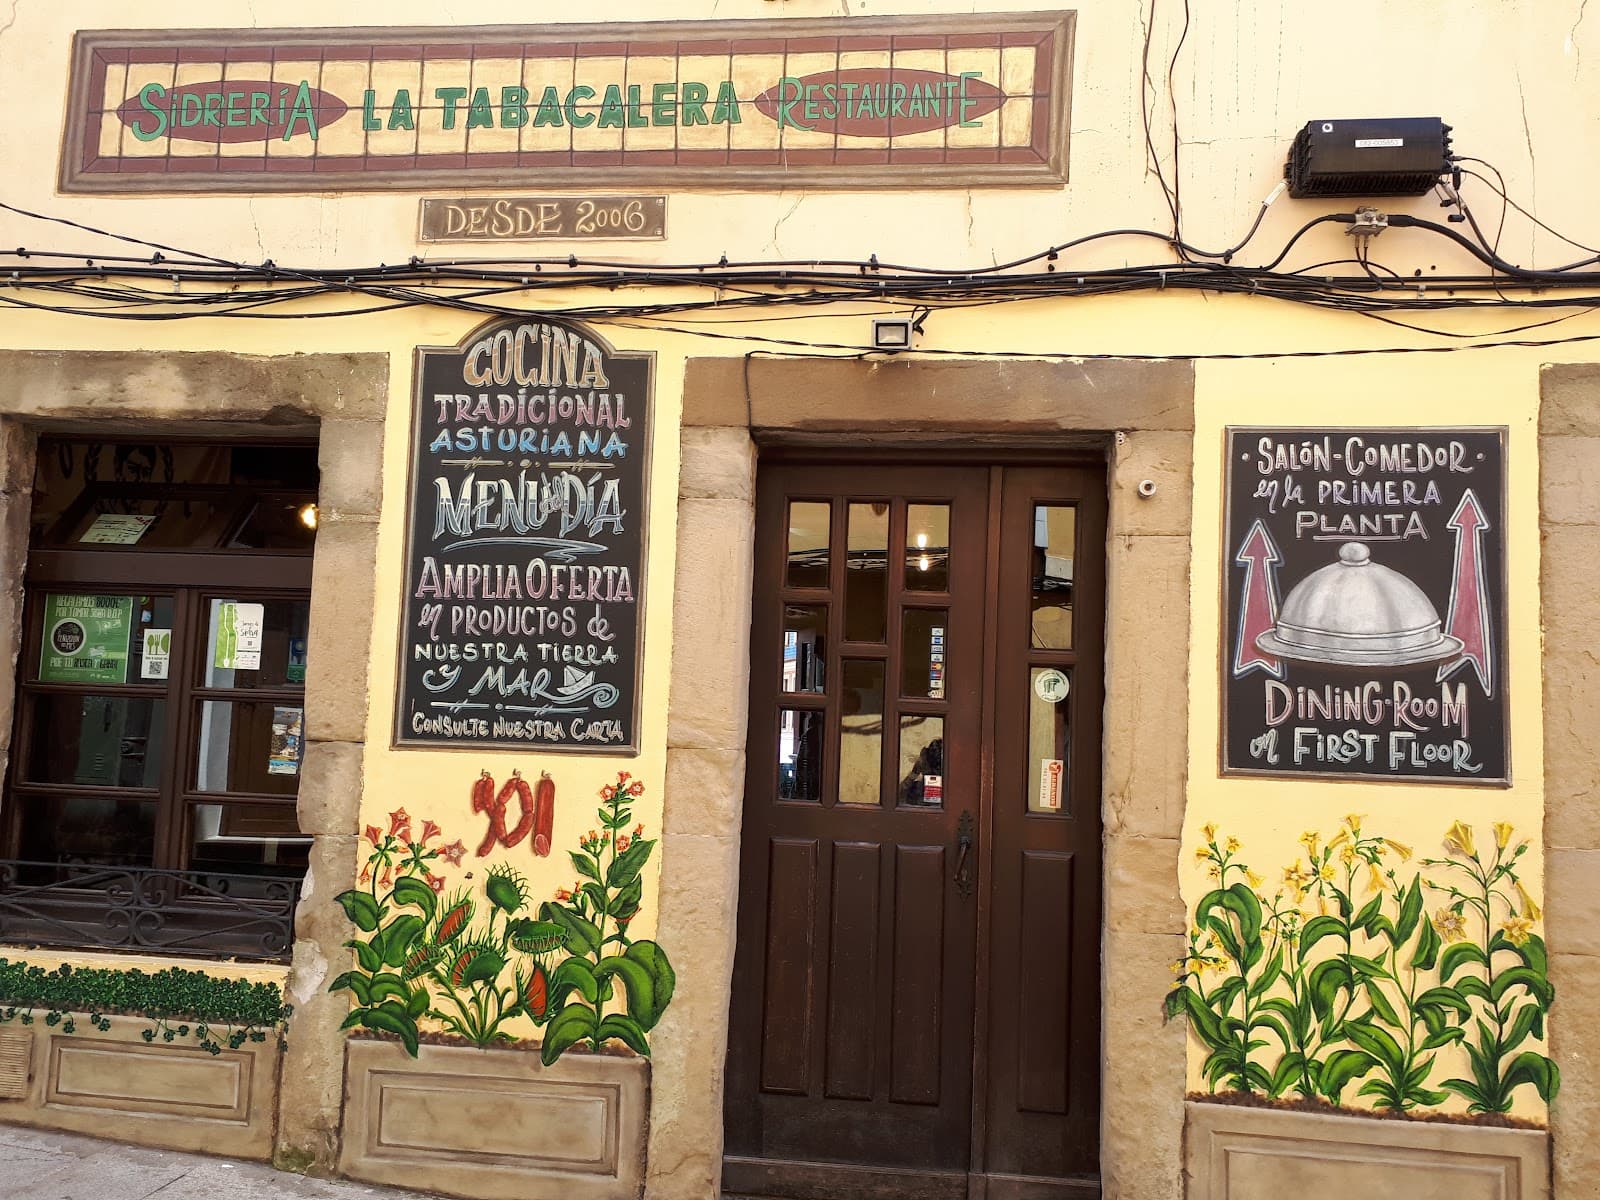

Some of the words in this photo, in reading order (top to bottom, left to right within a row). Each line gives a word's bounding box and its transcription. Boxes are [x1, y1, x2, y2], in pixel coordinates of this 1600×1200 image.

[363, 89, 415, 131] LA
[435, 81, 741, 130] TABACALERA
[778, 72, 982, 131] RESTAURANTE
[447, 200, 562, 236] DESDE
[575, 200, 645, 233] 2006
[1295, 510, 1430, 541] PLANTA
[414, 556, 523, 600] AMPLIA
[525, 558, 634, 602] OFERTA
[451, 605, 577, 637] PRODUCTOS
[414, 642, 528, 664] NUESTRA
[468, 664, 553, 701] MAR
[412, 711, 489, 738] CONSULTE
[492, 716, 566, 740] NUESTRA
[570, 717, 624, 743] CARTA
[1389, 731, 1484, 773] FLOOR
